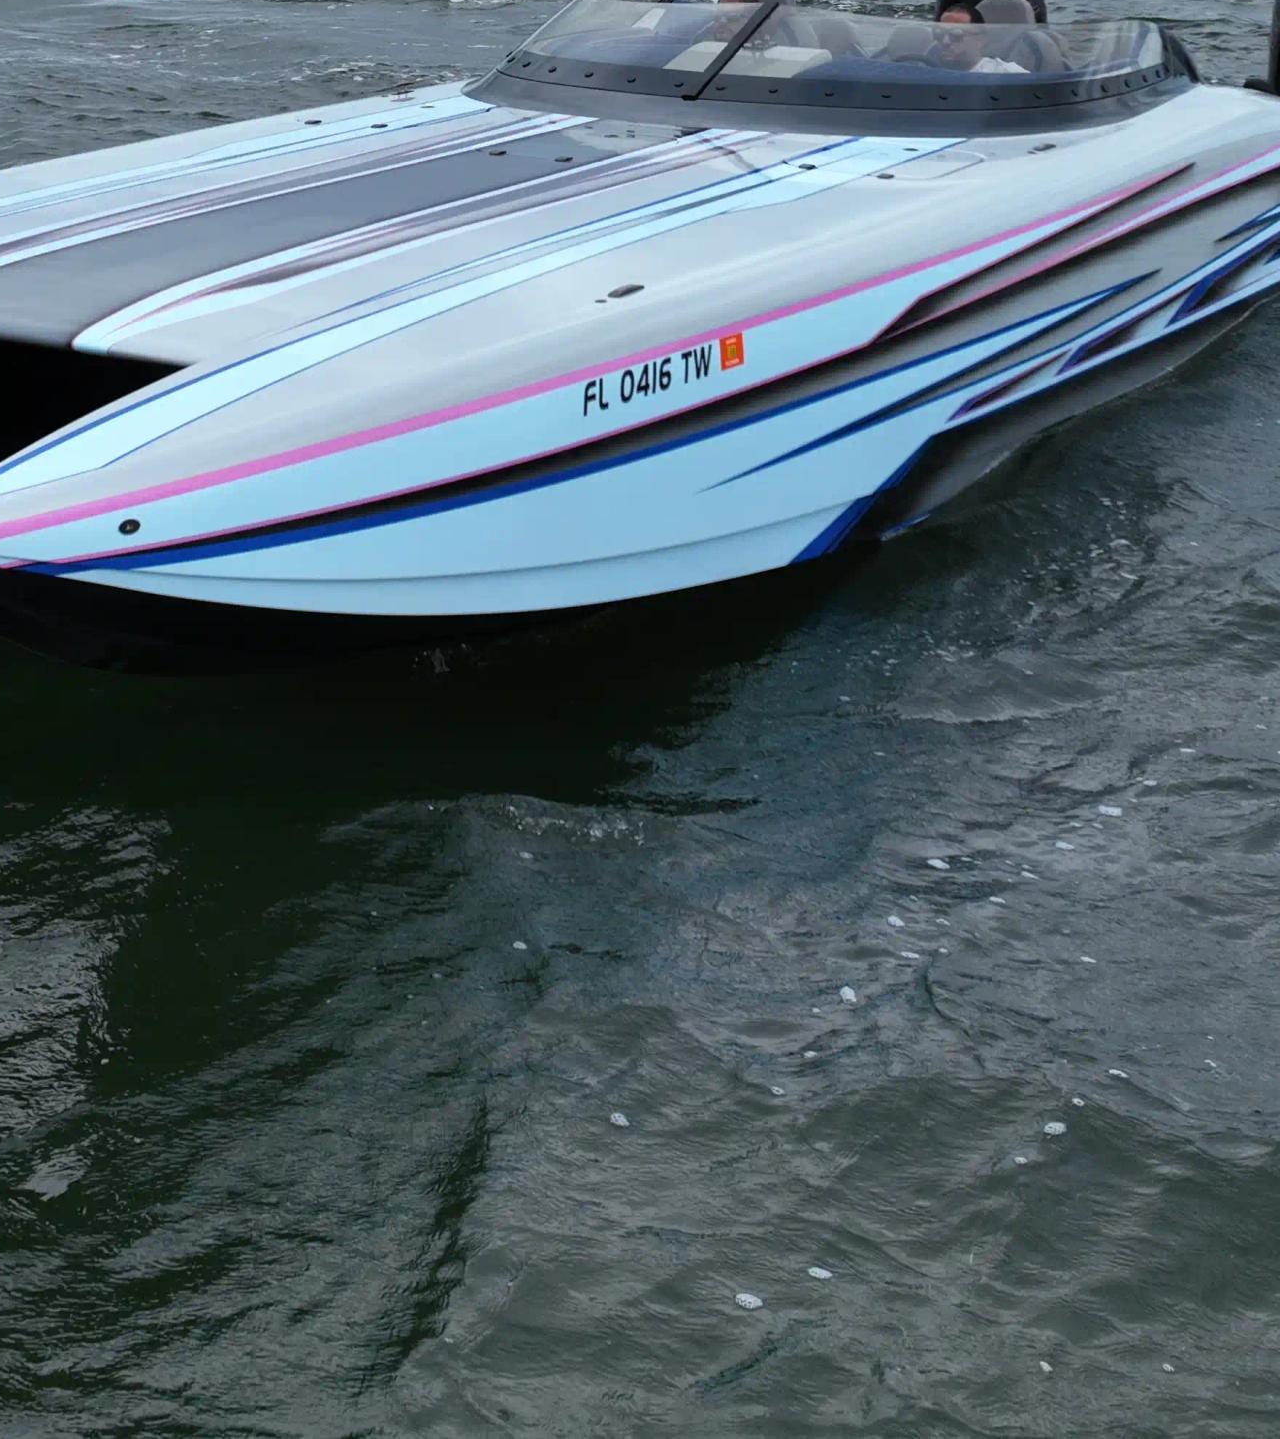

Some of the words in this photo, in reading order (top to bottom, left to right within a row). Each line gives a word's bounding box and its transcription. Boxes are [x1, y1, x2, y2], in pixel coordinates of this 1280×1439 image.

[583, 377, 609, 417] FL
[620, 356, 672, 404] 0416
[681, 344, 712, 384] TW
